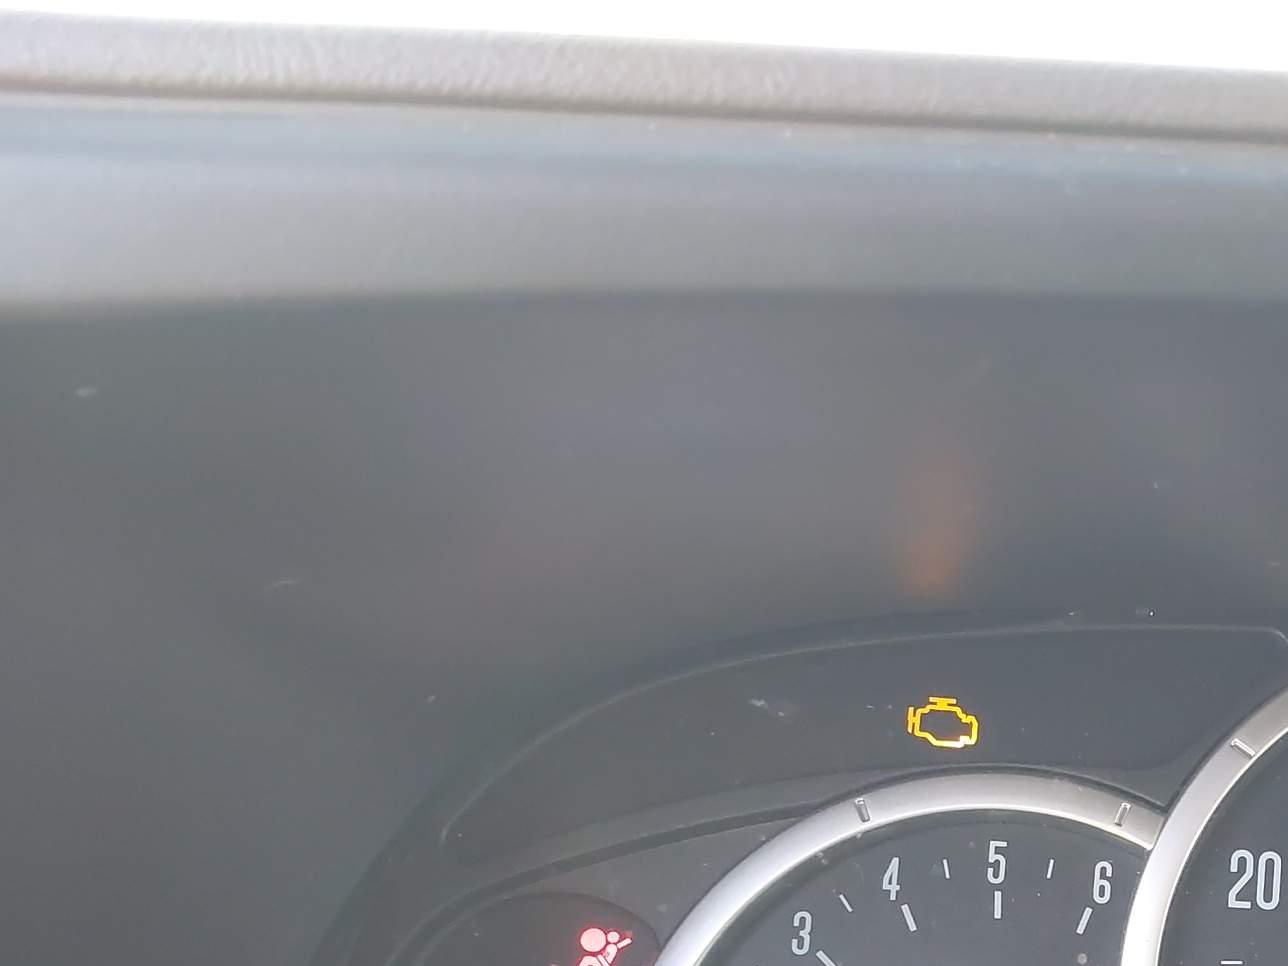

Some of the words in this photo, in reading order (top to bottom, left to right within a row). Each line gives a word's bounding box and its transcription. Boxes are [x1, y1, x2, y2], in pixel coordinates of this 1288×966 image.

[882, 857, 901, 901] 4
[986, 840, 1007, 884] 5
[1093, 862, 1112, 904] 6
[1228, 851, 1282, 909] 20
[791, 912, 811, 954] 3
